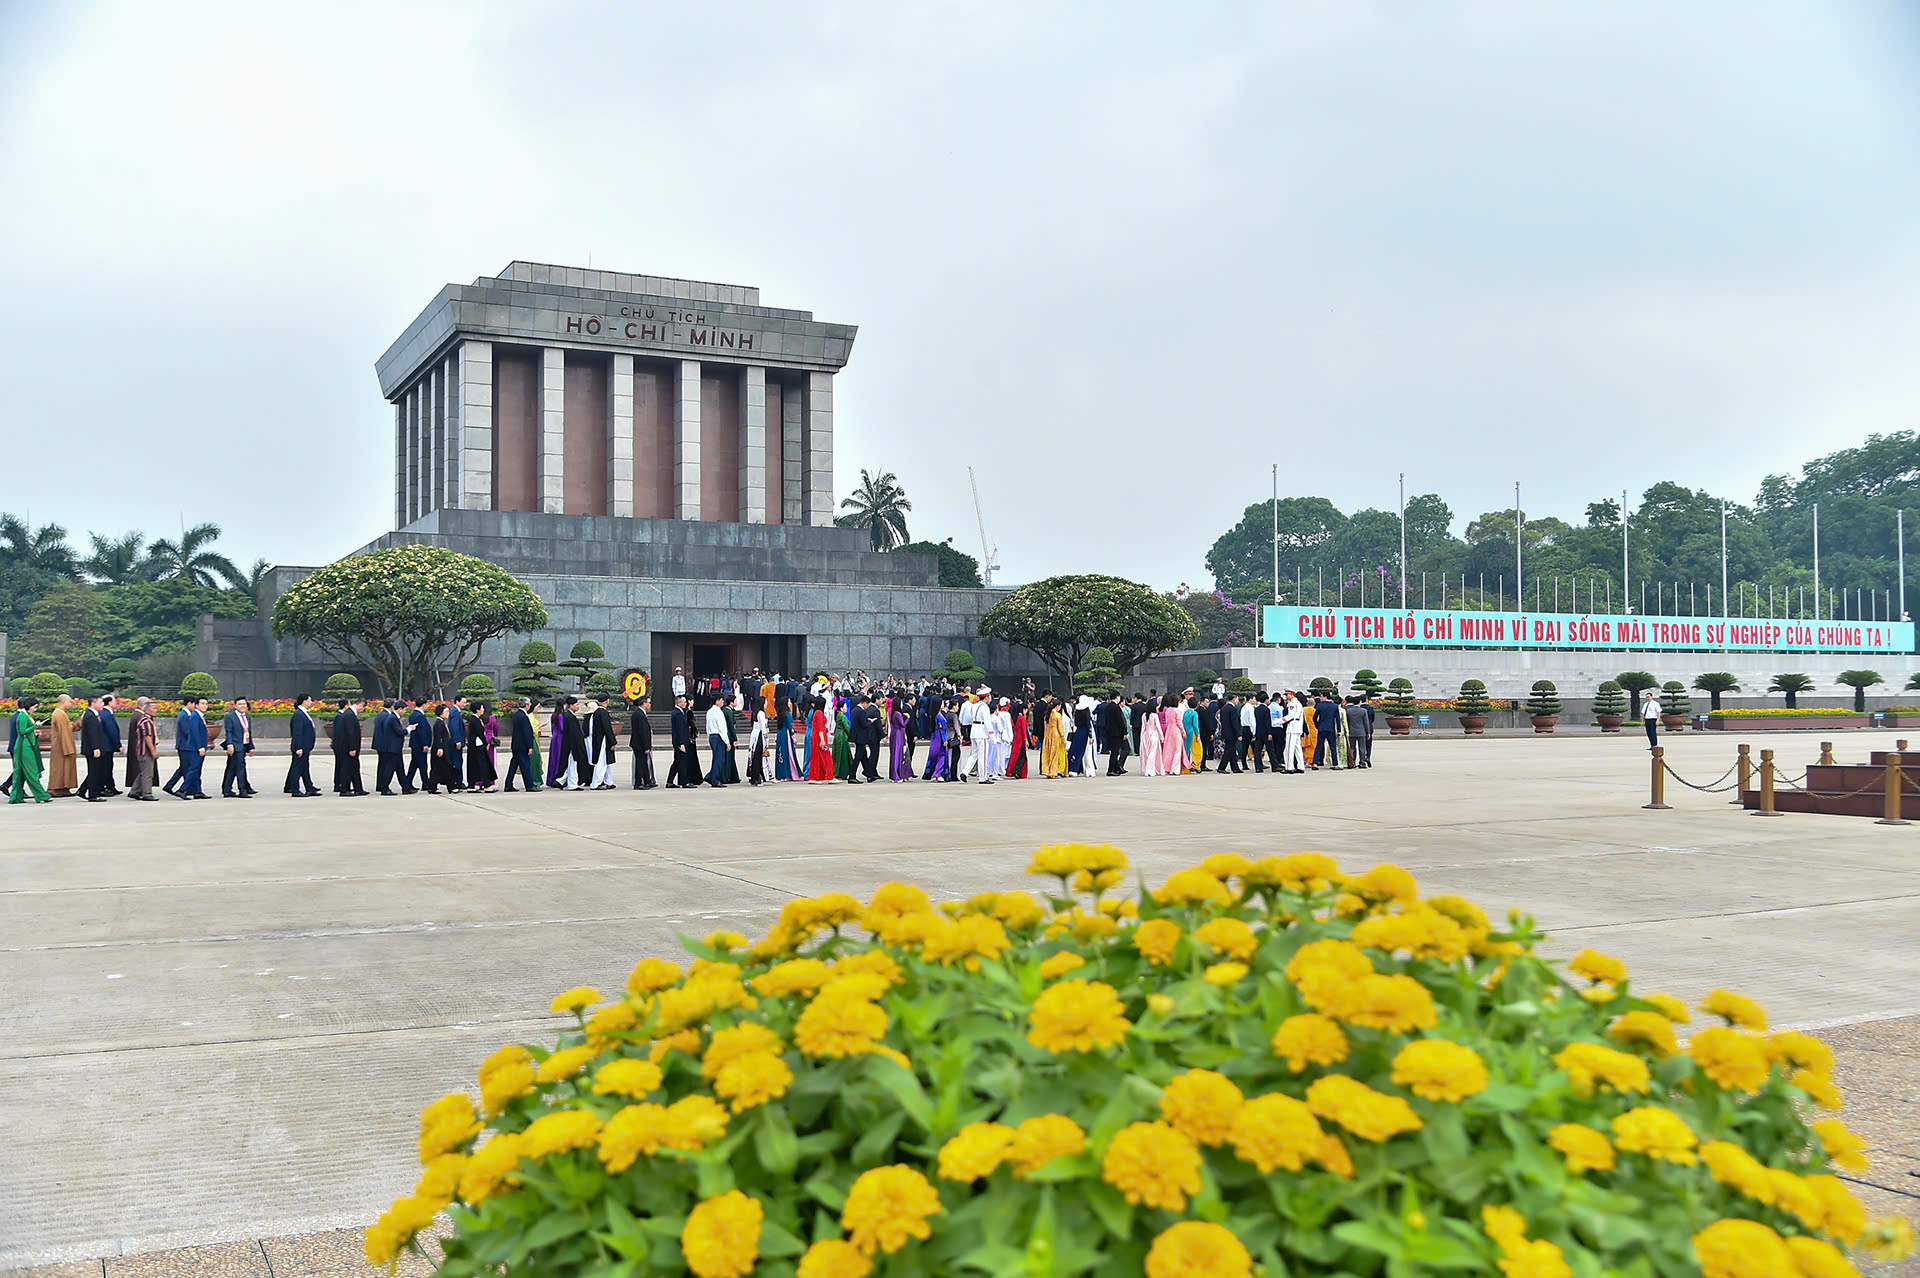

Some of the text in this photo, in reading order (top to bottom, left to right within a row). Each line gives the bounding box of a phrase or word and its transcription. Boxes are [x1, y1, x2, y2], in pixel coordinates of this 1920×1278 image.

[566, 315, 604, 336] HỒ
[624, 320, 672, 342] CHÍ
[1298, 608, 1336, 638] CHỦ
[1344, 616, 1385, 643] TỊCH
[1393, 610, 1416, 639] HỒ
[1424, 613, 1453, 640] CHÍ
[1460, 618, 1504, 641] MINH
[1512, 616, 1528, 641] VĨ
[1534, 620, 1561, 646] ĐẠI
[1568, 614, 1611, 642] SỐNG
[1617, 619, 1646, 643] MÃI
[1652, 623, 1701, 643] TRONG
[1706, 622, 1726, 648] SỰ
[1730, 621, 1781, 648] NGHIỆP
[1786, 620, 1813, 646] CỦA
[1818, 623, 1862, 647] CHÚNG
[1866, 628, 1882, 647] TA
